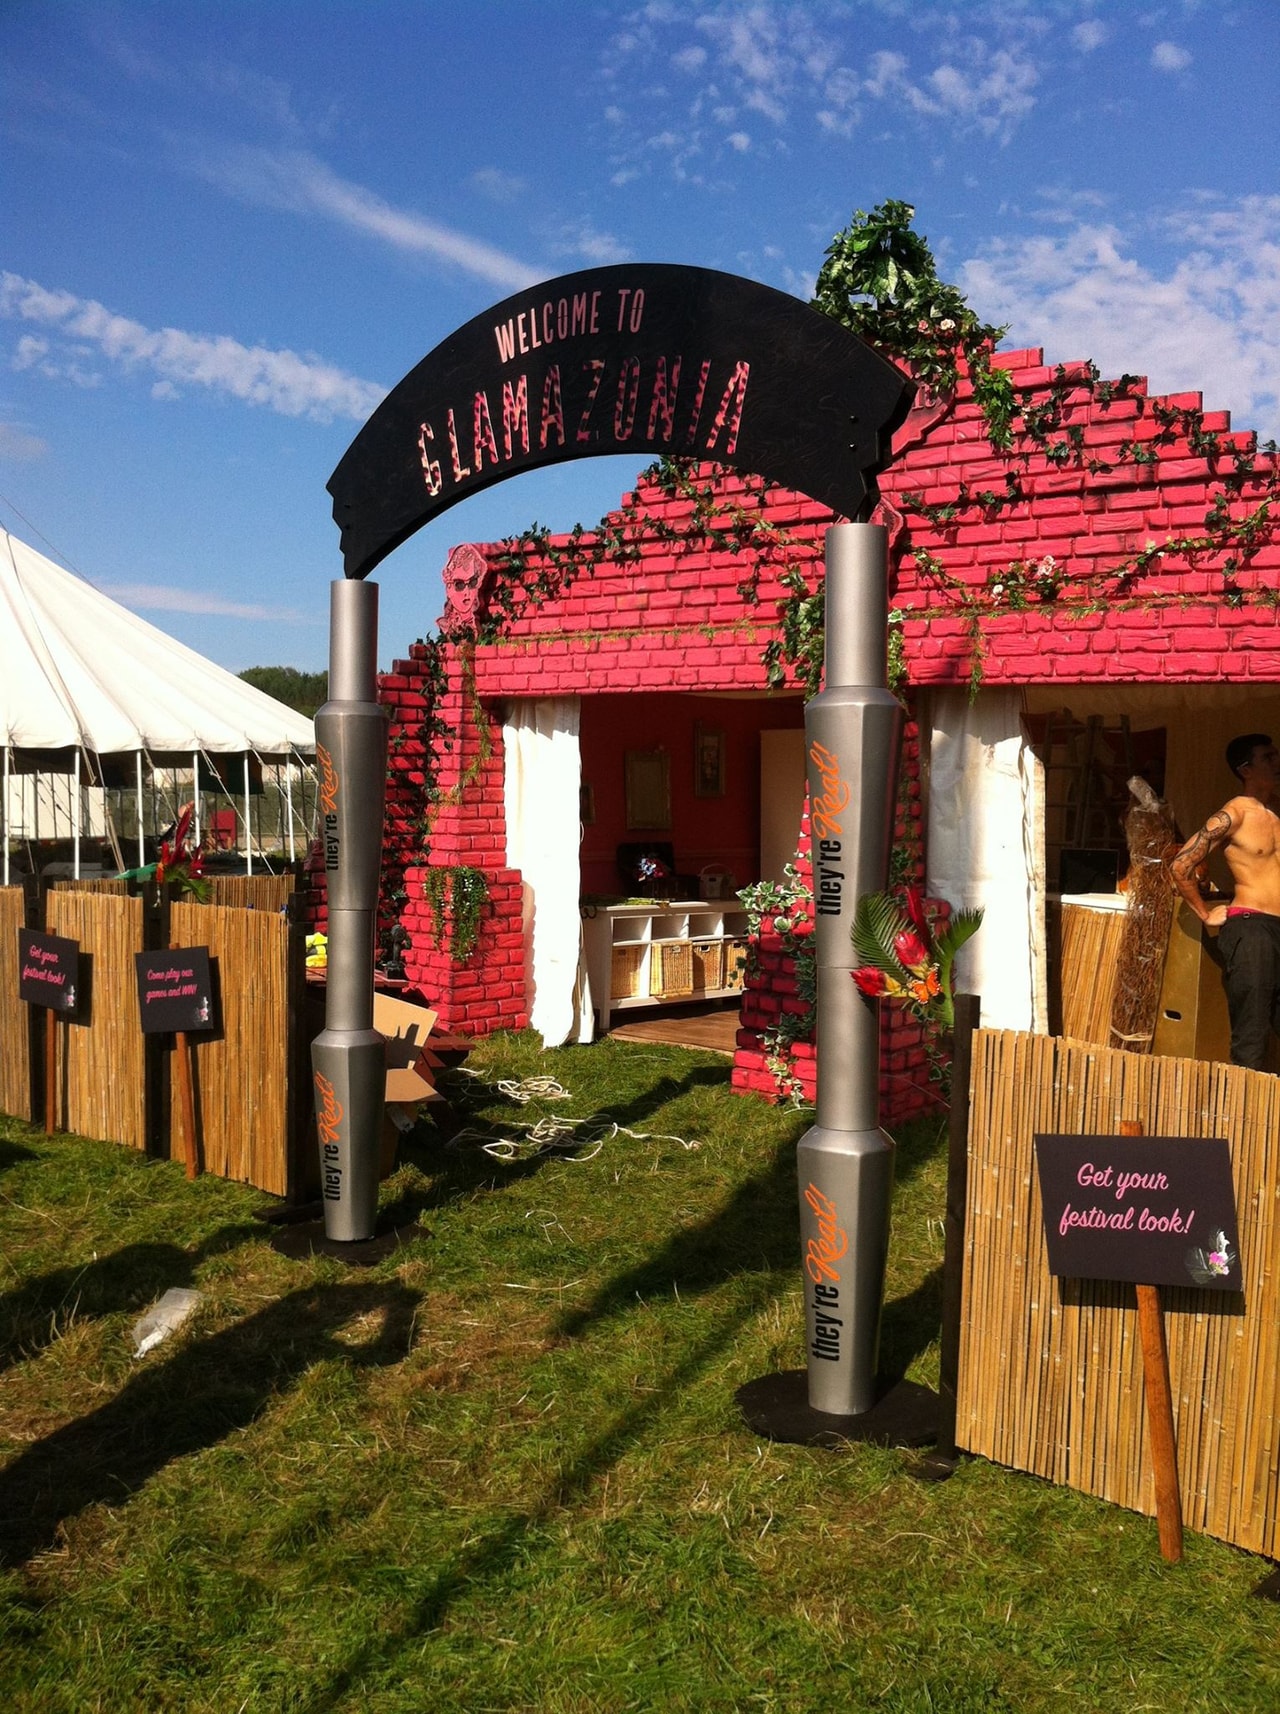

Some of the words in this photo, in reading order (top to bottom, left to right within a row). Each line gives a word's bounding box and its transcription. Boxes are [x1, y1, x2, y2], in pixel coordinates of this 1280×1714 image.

[494, 290, 601, 364] WELCOME
[616, 288, 646, 334] TO
[416, 353, 751, 497] GLAMAZONIA
[317, 742, 340, 815] Real!
[809, 740, 851, 840] Real!
[324, 814, 340, 871] they're
[815, 839, 846, 917] they're
[22, 964, 47, 980] festival
[47, 970, 66, 985] look!
[29, 944, 41, 958] Get
[41, 951, 59, 965] your
[147, 969, 164, 979] Come
[164, 967, 180, 983] play
[181, 968, 193, 977] our
[146, 988, 167, 1004] games
[167, 984, 181, 997] and
[314, 1071, 344, 1144] Real!
[322, 1143, 343, 1202] they're
[1076, 1162, 1114, 1189] Get
[1114, 1171, 1170, 1201] your
[803, 1181, 849, 1284] Real!
[1058, 1202, 1135, 1237] festival
[1137, 1206, 1196, 1235] look!
[811, 1283, 844, 1362] they're
